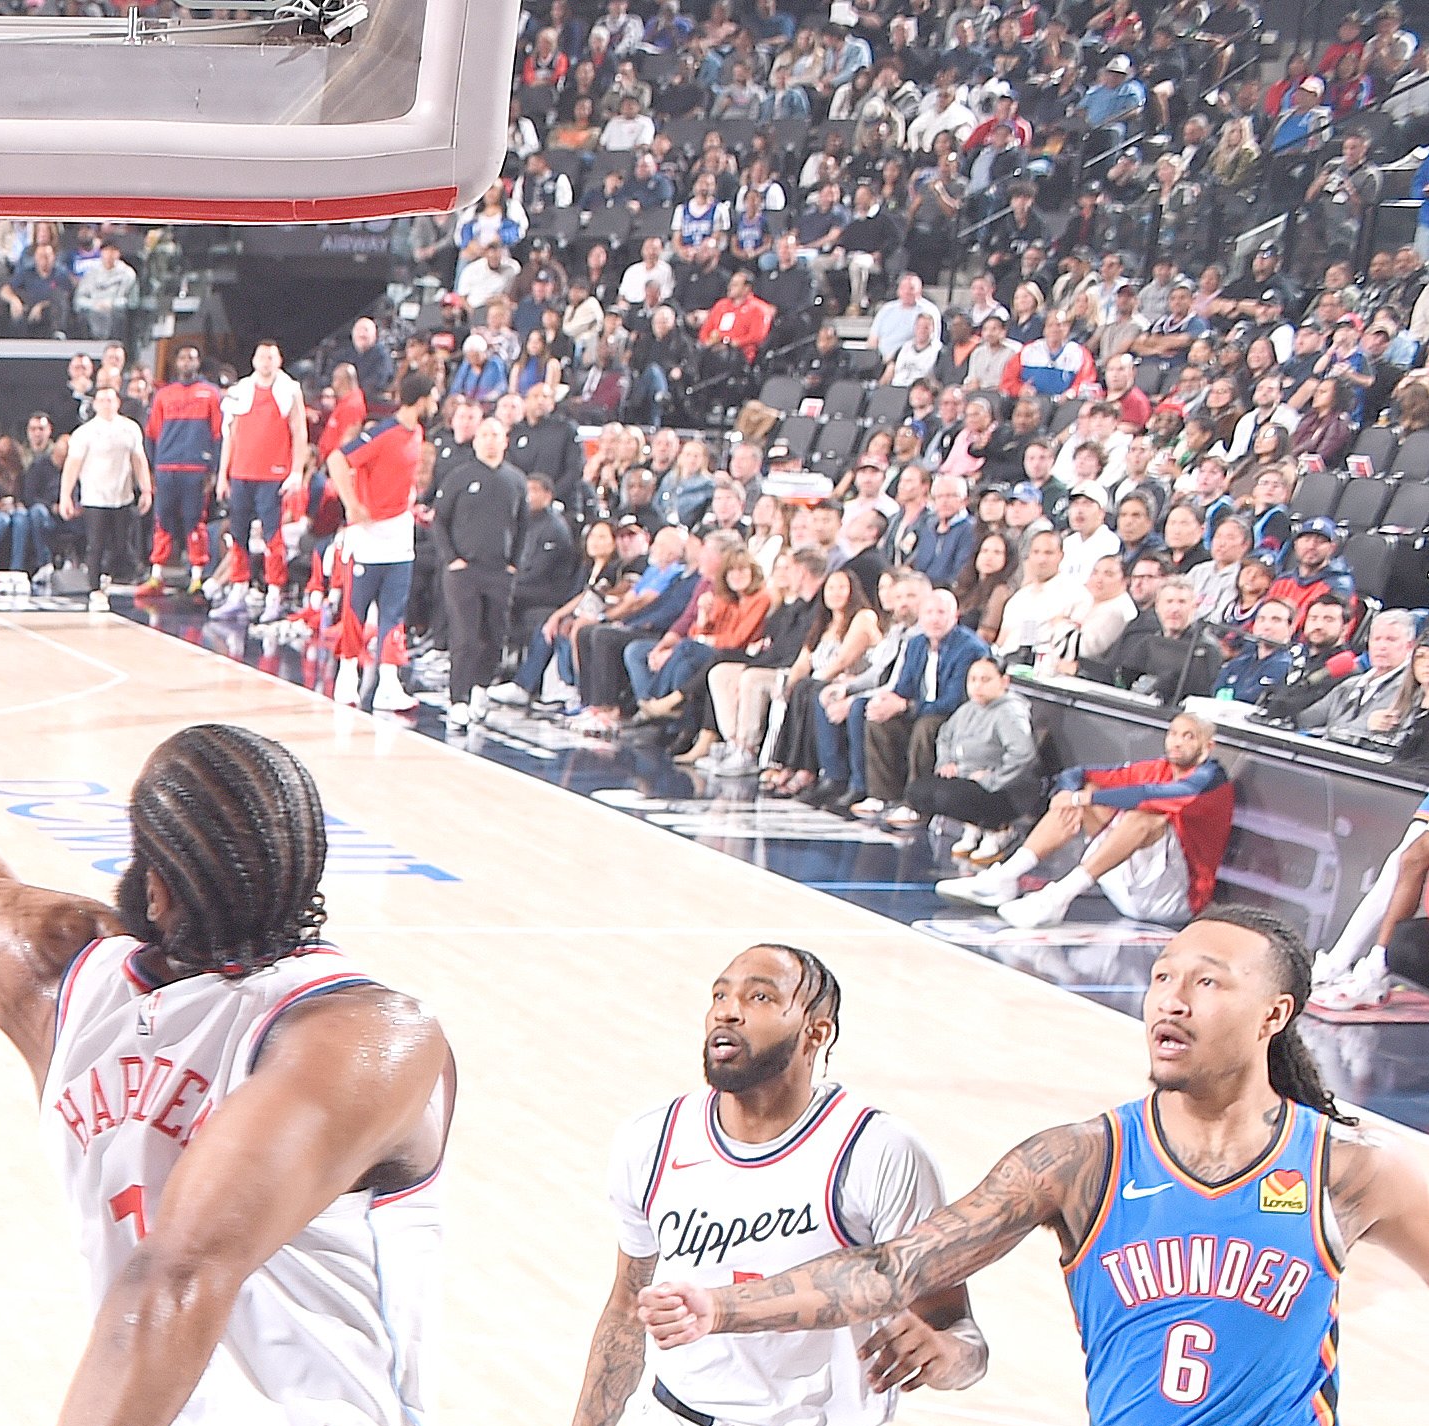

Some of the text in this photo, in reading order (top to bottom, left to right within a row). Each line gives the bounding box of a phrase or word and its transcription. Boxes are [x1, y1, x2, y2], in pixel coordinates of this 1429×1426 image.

[320, 234, 391, 252] AIRWAY
[53, 1055, 217, 1157] HARDE
[657, 1202, 820, 1268] Clippers
[1099, 1234, 1311, 1321] THUNDER
[1161, 1319, 1216, 1406] 6
